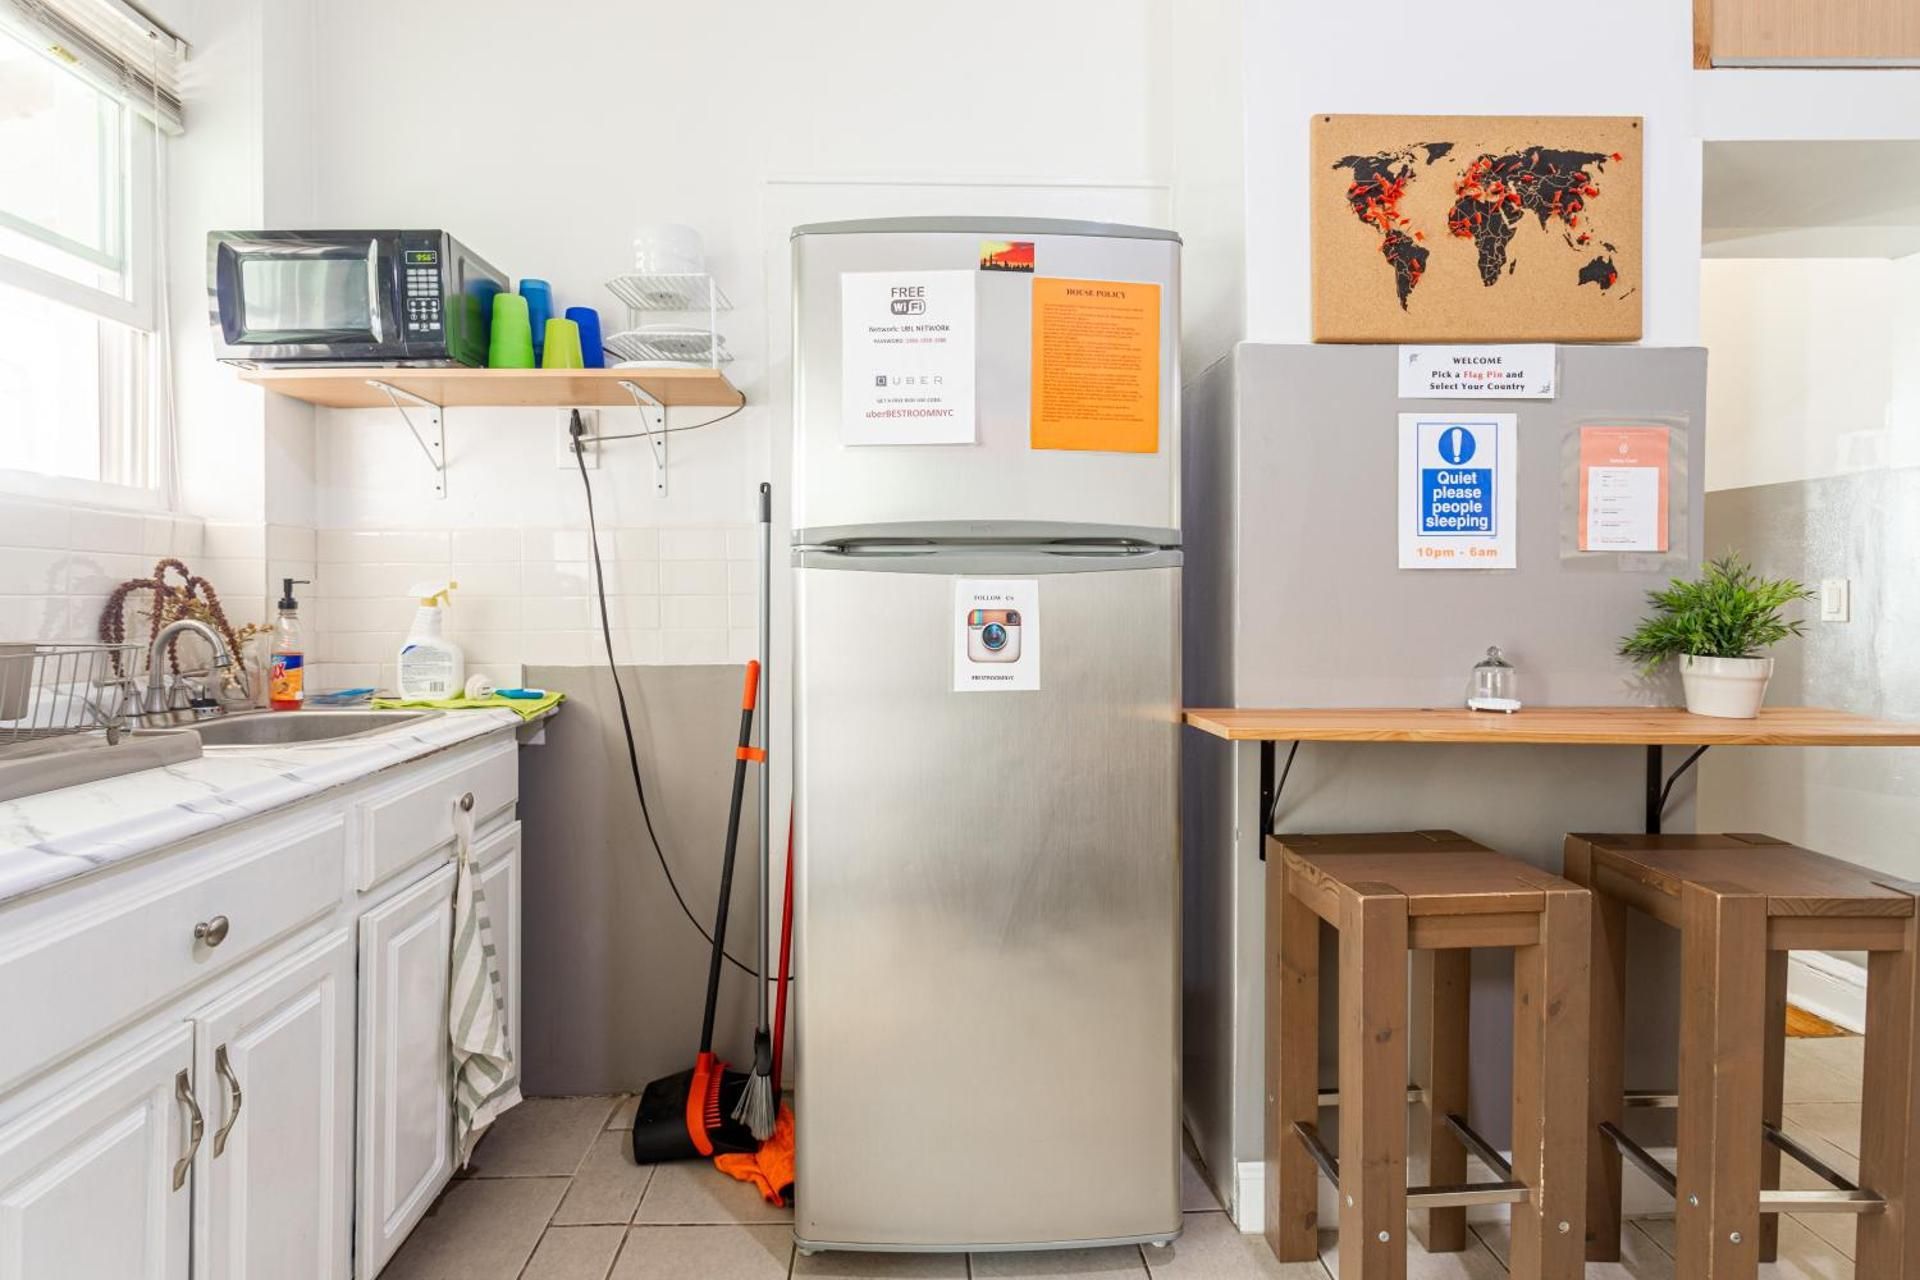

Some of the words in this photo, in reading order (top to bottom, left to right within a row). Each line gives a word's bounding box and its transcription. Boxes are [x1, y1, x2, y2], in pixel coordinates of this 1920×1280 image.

[891, 286, 925, 298] FREE
[1096, 289, 1126, 299] POLICY
[1453, 356, 1503, 365] WELCOME
[889, 375, 944, 386] UBER
[1432, 370, 1452, 378] Pick
[1463, 370, 1484, 380] Flag
[1487, 370, 1503, 378] Pin
[1505, 370, 1523, 378] and
[1430, 382, 1458, 390] Select
[1461, 382, 1484, 390] Your
[1487, 382, 1525, 392] Country
[1437, 471, 1477, 485] Quiet
[1433, 485, 1482, 501] please
[1432, 500, 1482, 516] people
[1425, 514, 1488, 530] sleeping
[1417, 546, 1455, 559] 10pm
[1469, 546, 1498, 557] 6am
